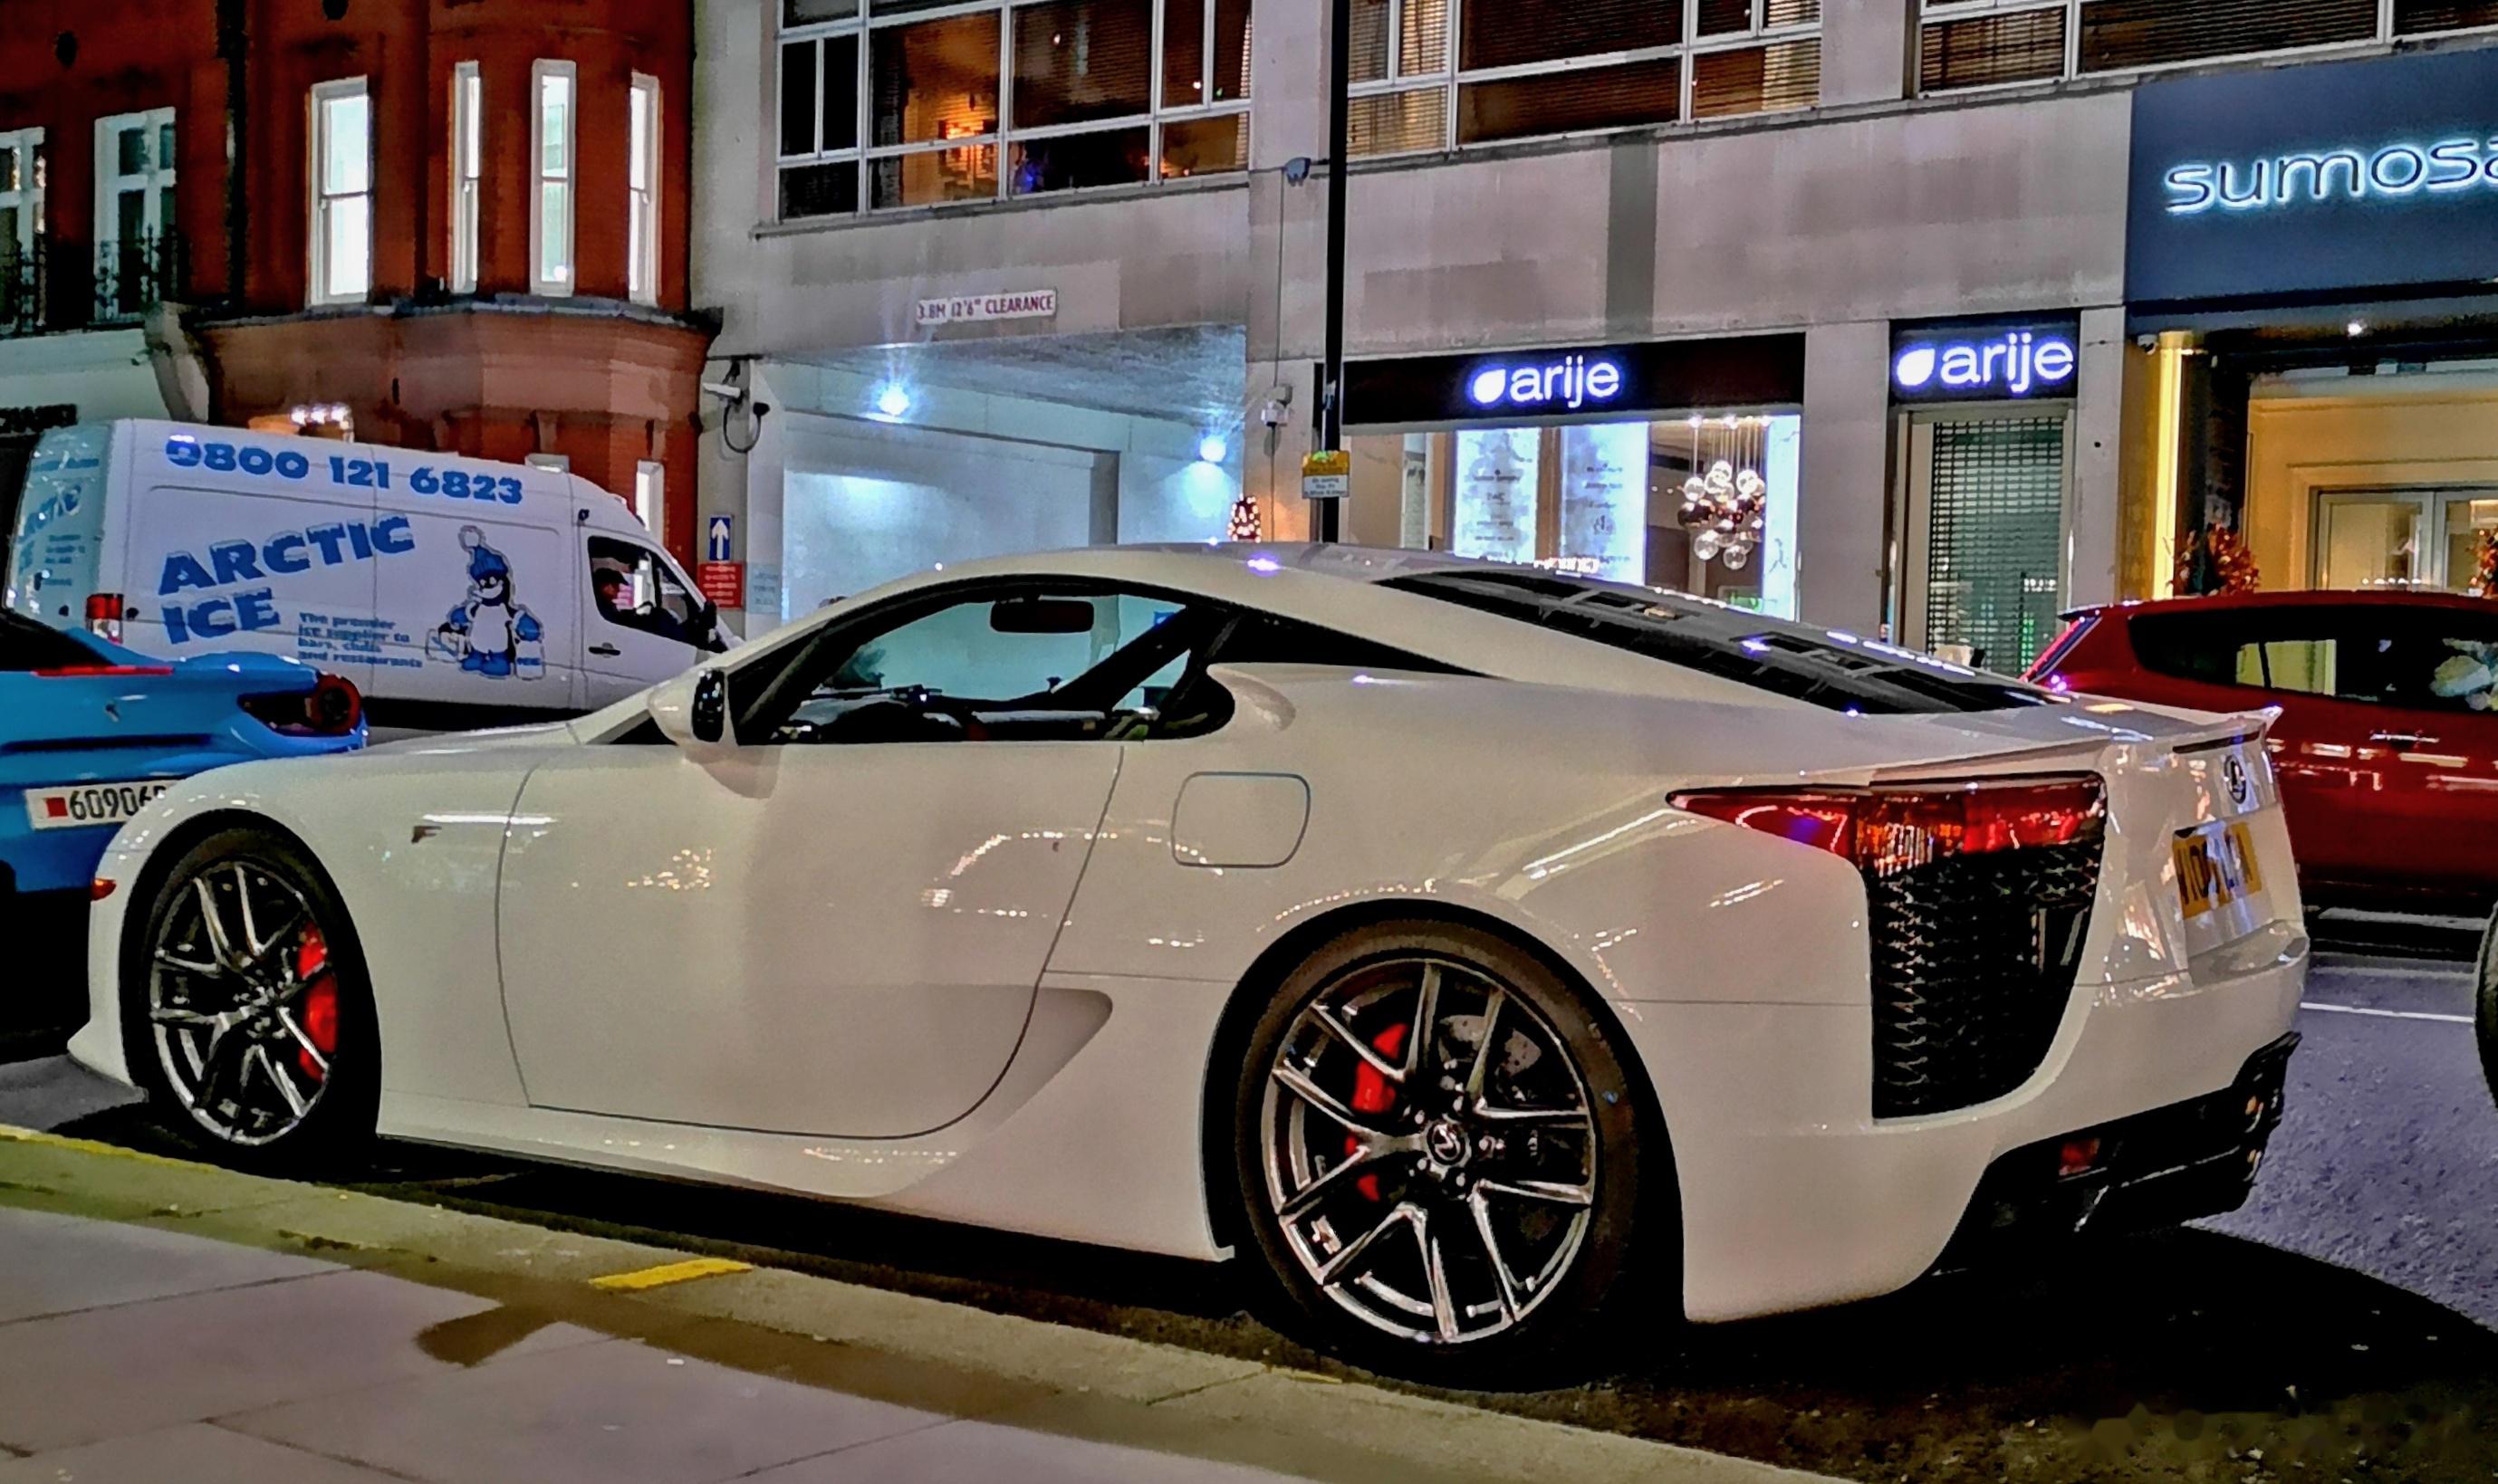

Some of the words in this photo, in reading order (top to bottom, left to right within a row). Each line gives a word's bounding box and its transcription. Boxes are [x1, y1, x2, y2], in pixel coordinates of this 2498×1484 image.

[2165, 136, 2498, 214] sumos
[985, 294, 1053, 314] CLEARANCE
[1510, 355, 1619, 408] arije
[1941, 332, 2074, 393] arije
[166, 435, 310, 480] 0800
[329, 455, 389, 489] 121
[410, 466, 523, 505] 6823
[159, 512, 416, 596] ARCTIC
[161, 587, 281, 646] ICE
